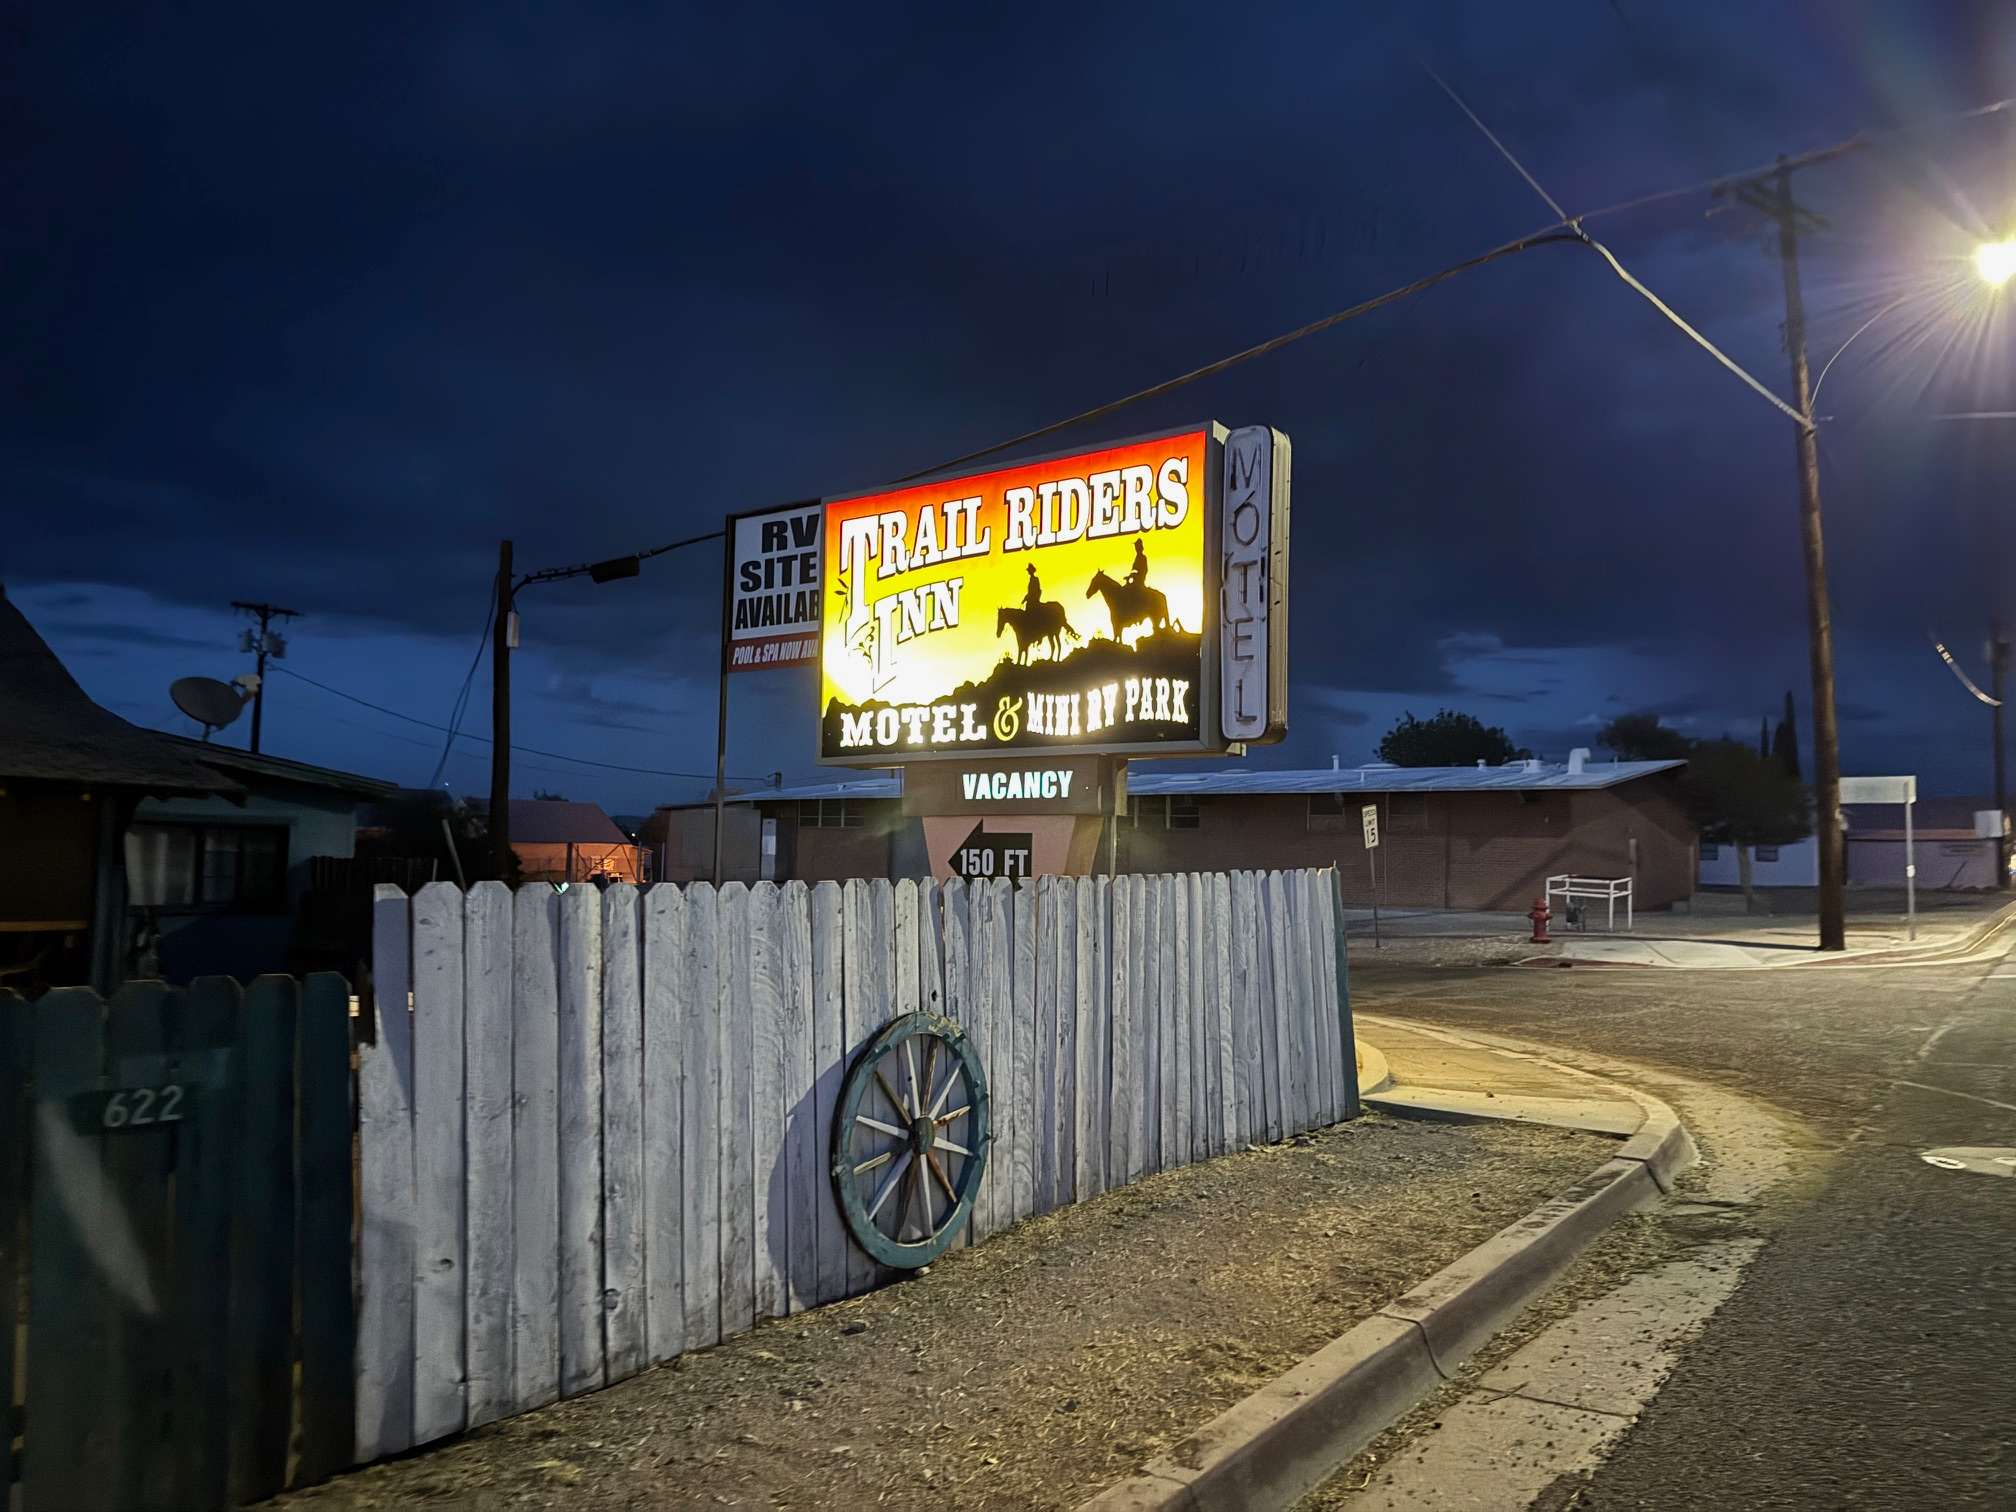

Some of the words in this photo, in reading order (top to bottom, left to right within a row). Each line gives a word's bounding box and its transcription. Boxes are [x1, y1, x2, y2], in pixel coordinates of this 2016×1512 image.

[762, 514, 820, 554] RV
[840, 496, 990, 645] TRAIL
[1003, 456, 1190, 551] RIDERS
[1230, 447, 1262, 723] MOTEL
[873, 563, 964, 694] INN
[732, 645, 754, 665] POOL
[754, 647, 762, 663] &
[762, 643, 779, 662] SPA
[779, 640, 802, 660] NOW
[839, 703, 987, 748] MOTEL
[993, 696, 1023, 742] &
[1026, 691, 1081, 737] MINI
[1086, 683, 1119, 733] RV
[1124, 677, 1190, 725] PARK
[962, 770, 1073, 800] VACANCY
[1366, 827, 1377, 845] 15
[960, 848, 994, 876] 150
[1004, 849, 1029, 877] FT
[103, 1085, 184, 1127] 622
